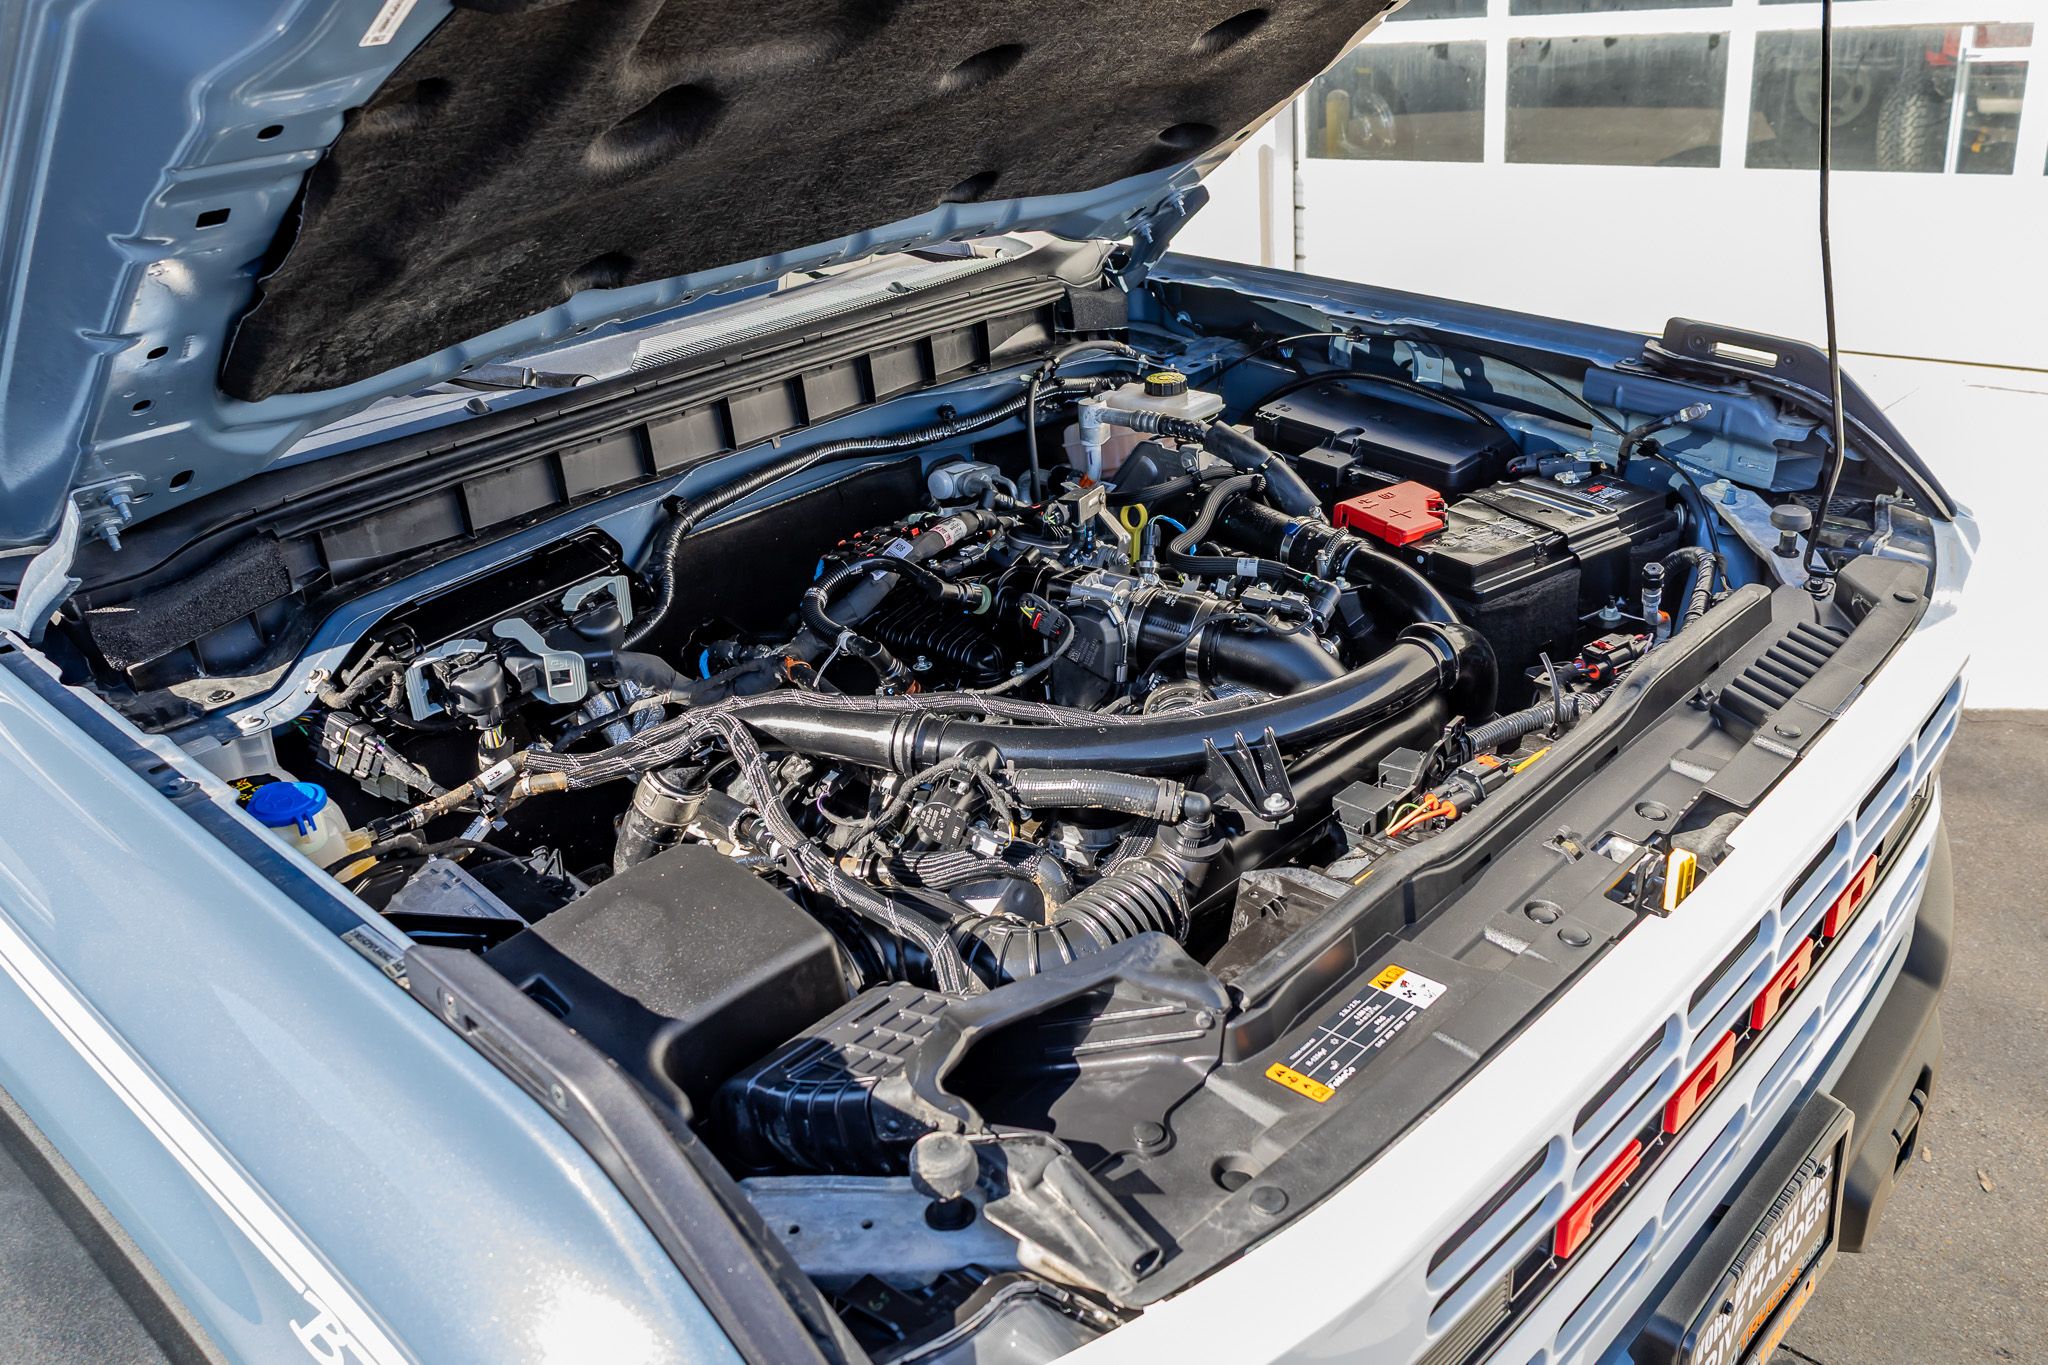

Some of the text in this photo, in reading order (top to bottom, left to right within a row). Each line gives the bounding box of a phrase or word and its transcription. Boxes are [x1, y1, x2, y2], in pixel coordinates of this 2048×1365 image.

[1555, 854, 1877, 1259] FORD
[1747, 1187, 1831, 1312] HARDER.
[1770, 1198, 1801, 1256] PLAY
